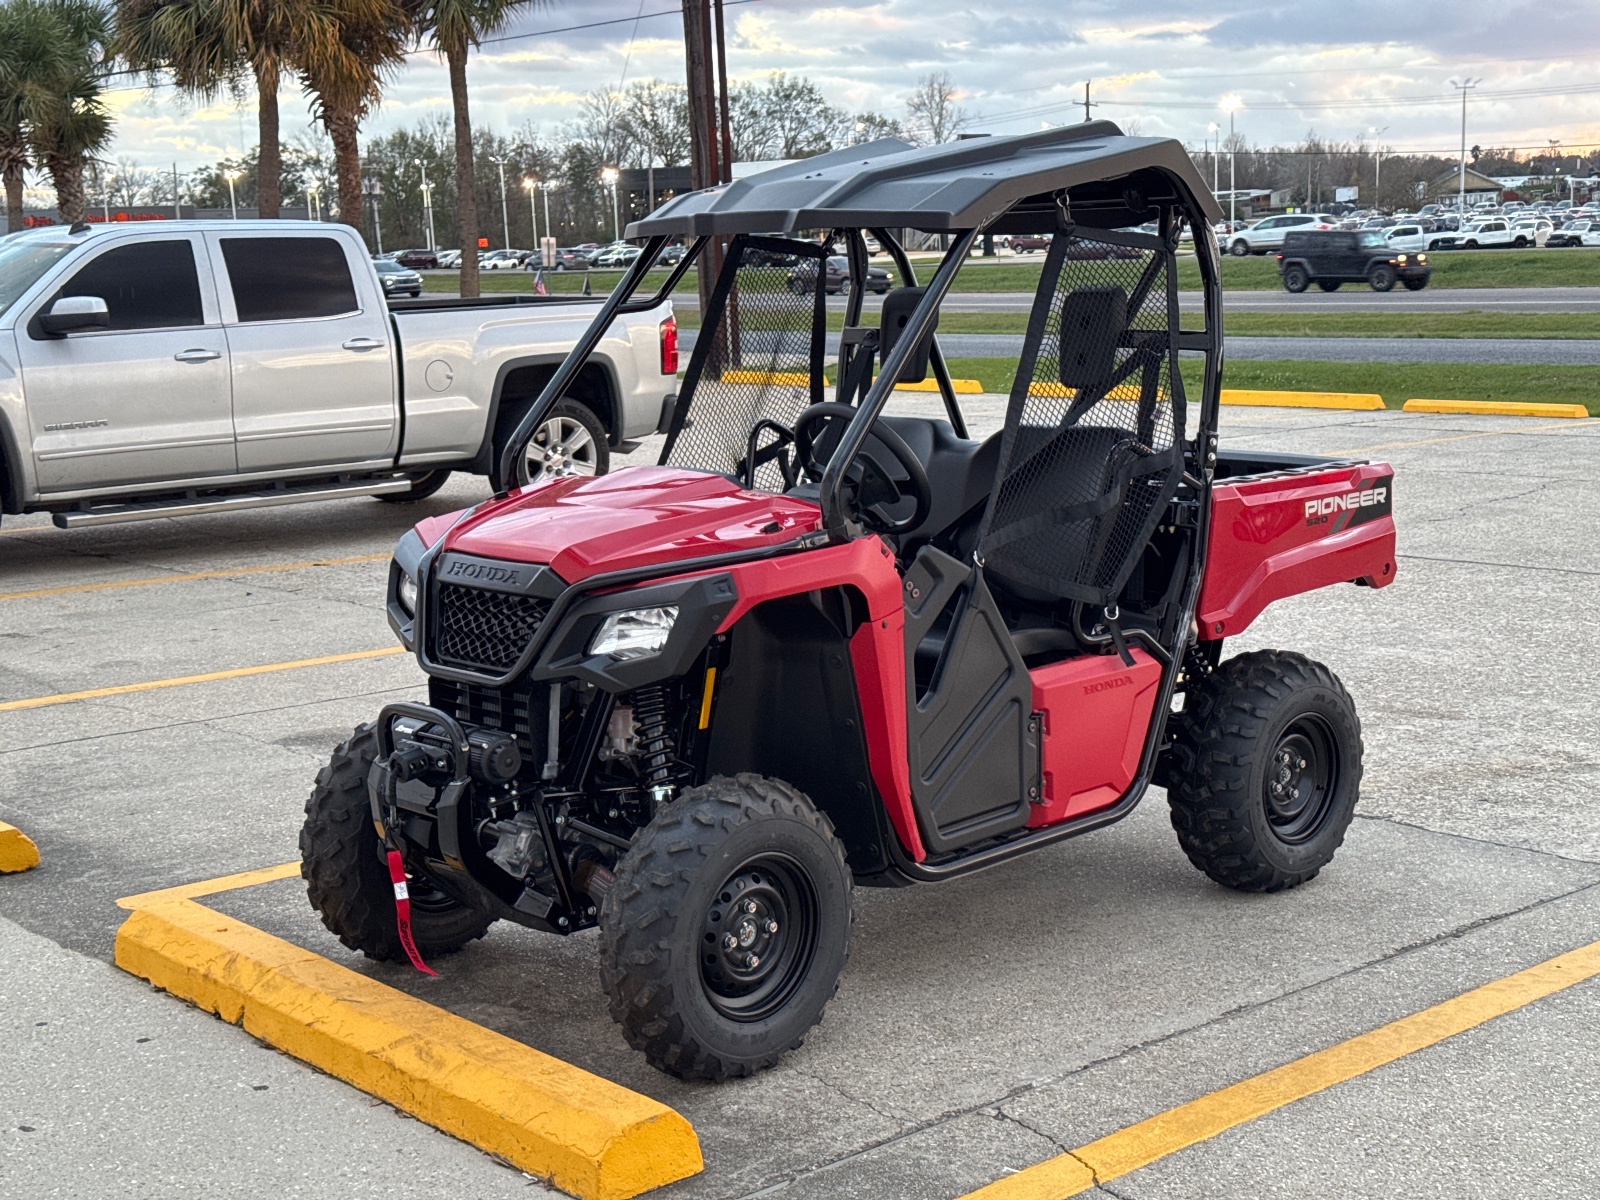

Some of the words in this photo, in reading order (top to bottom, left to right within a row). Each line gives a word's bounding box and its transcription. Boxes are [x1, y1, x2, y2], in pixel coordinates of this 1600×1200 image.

[1305, 487, 1387, 518] PIONEER
[1306, 516, 1328, 527] 520
[447, 561, 520, 585] HONDA
[1083, 676, 1135, 695] HONDA
